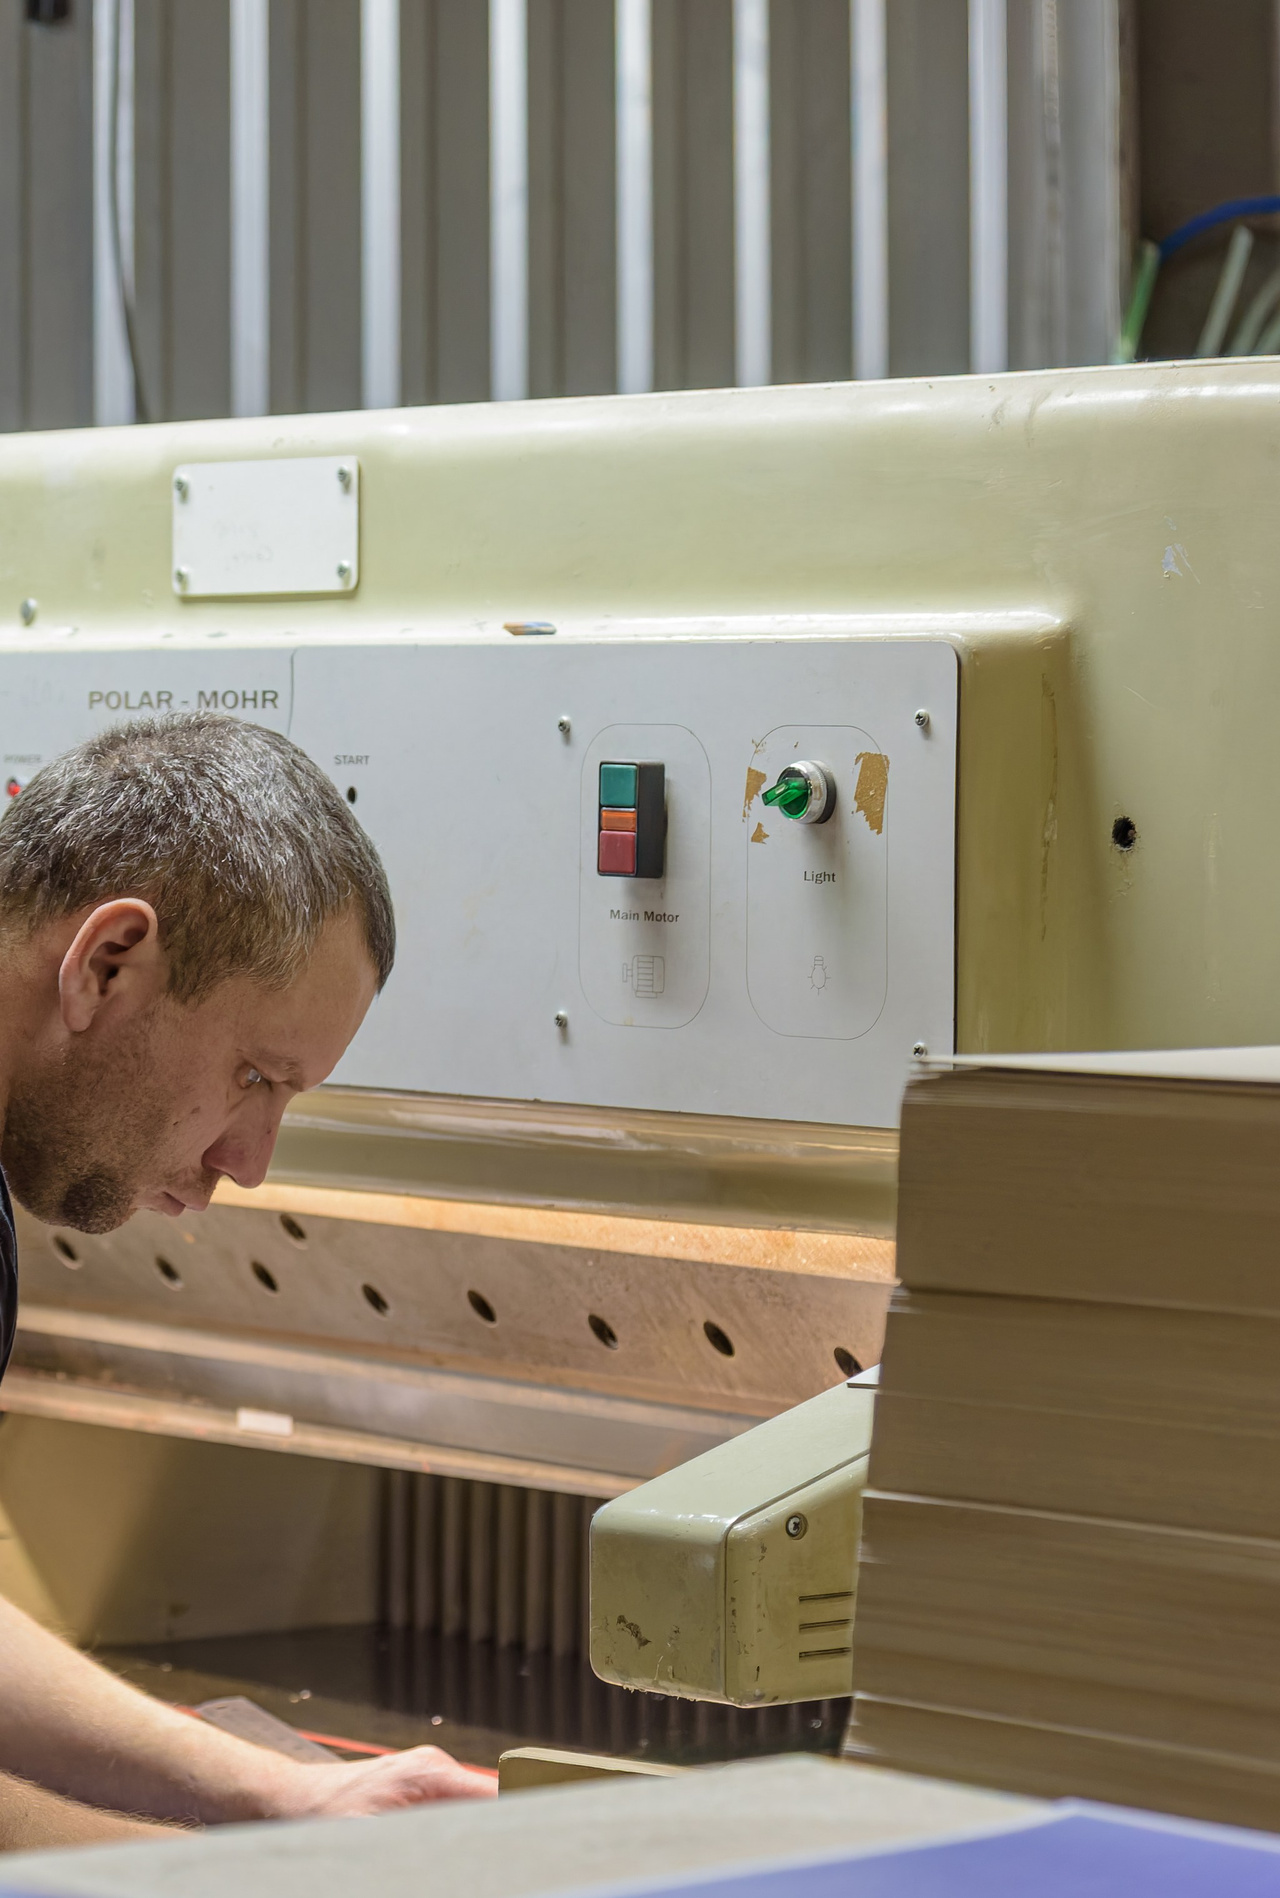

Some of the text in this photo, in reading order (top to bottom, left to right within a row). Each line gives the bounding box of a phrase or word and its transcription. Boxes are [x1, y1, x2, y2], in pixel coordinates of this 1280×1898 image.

[88, 691, 173, 710] POLAR
[197, 690, 279, 709] MOHR
[334, 754, 371, 765] START
[803, 870, 836, 885] Light
[609, 909, 680, 923] Main Motor
